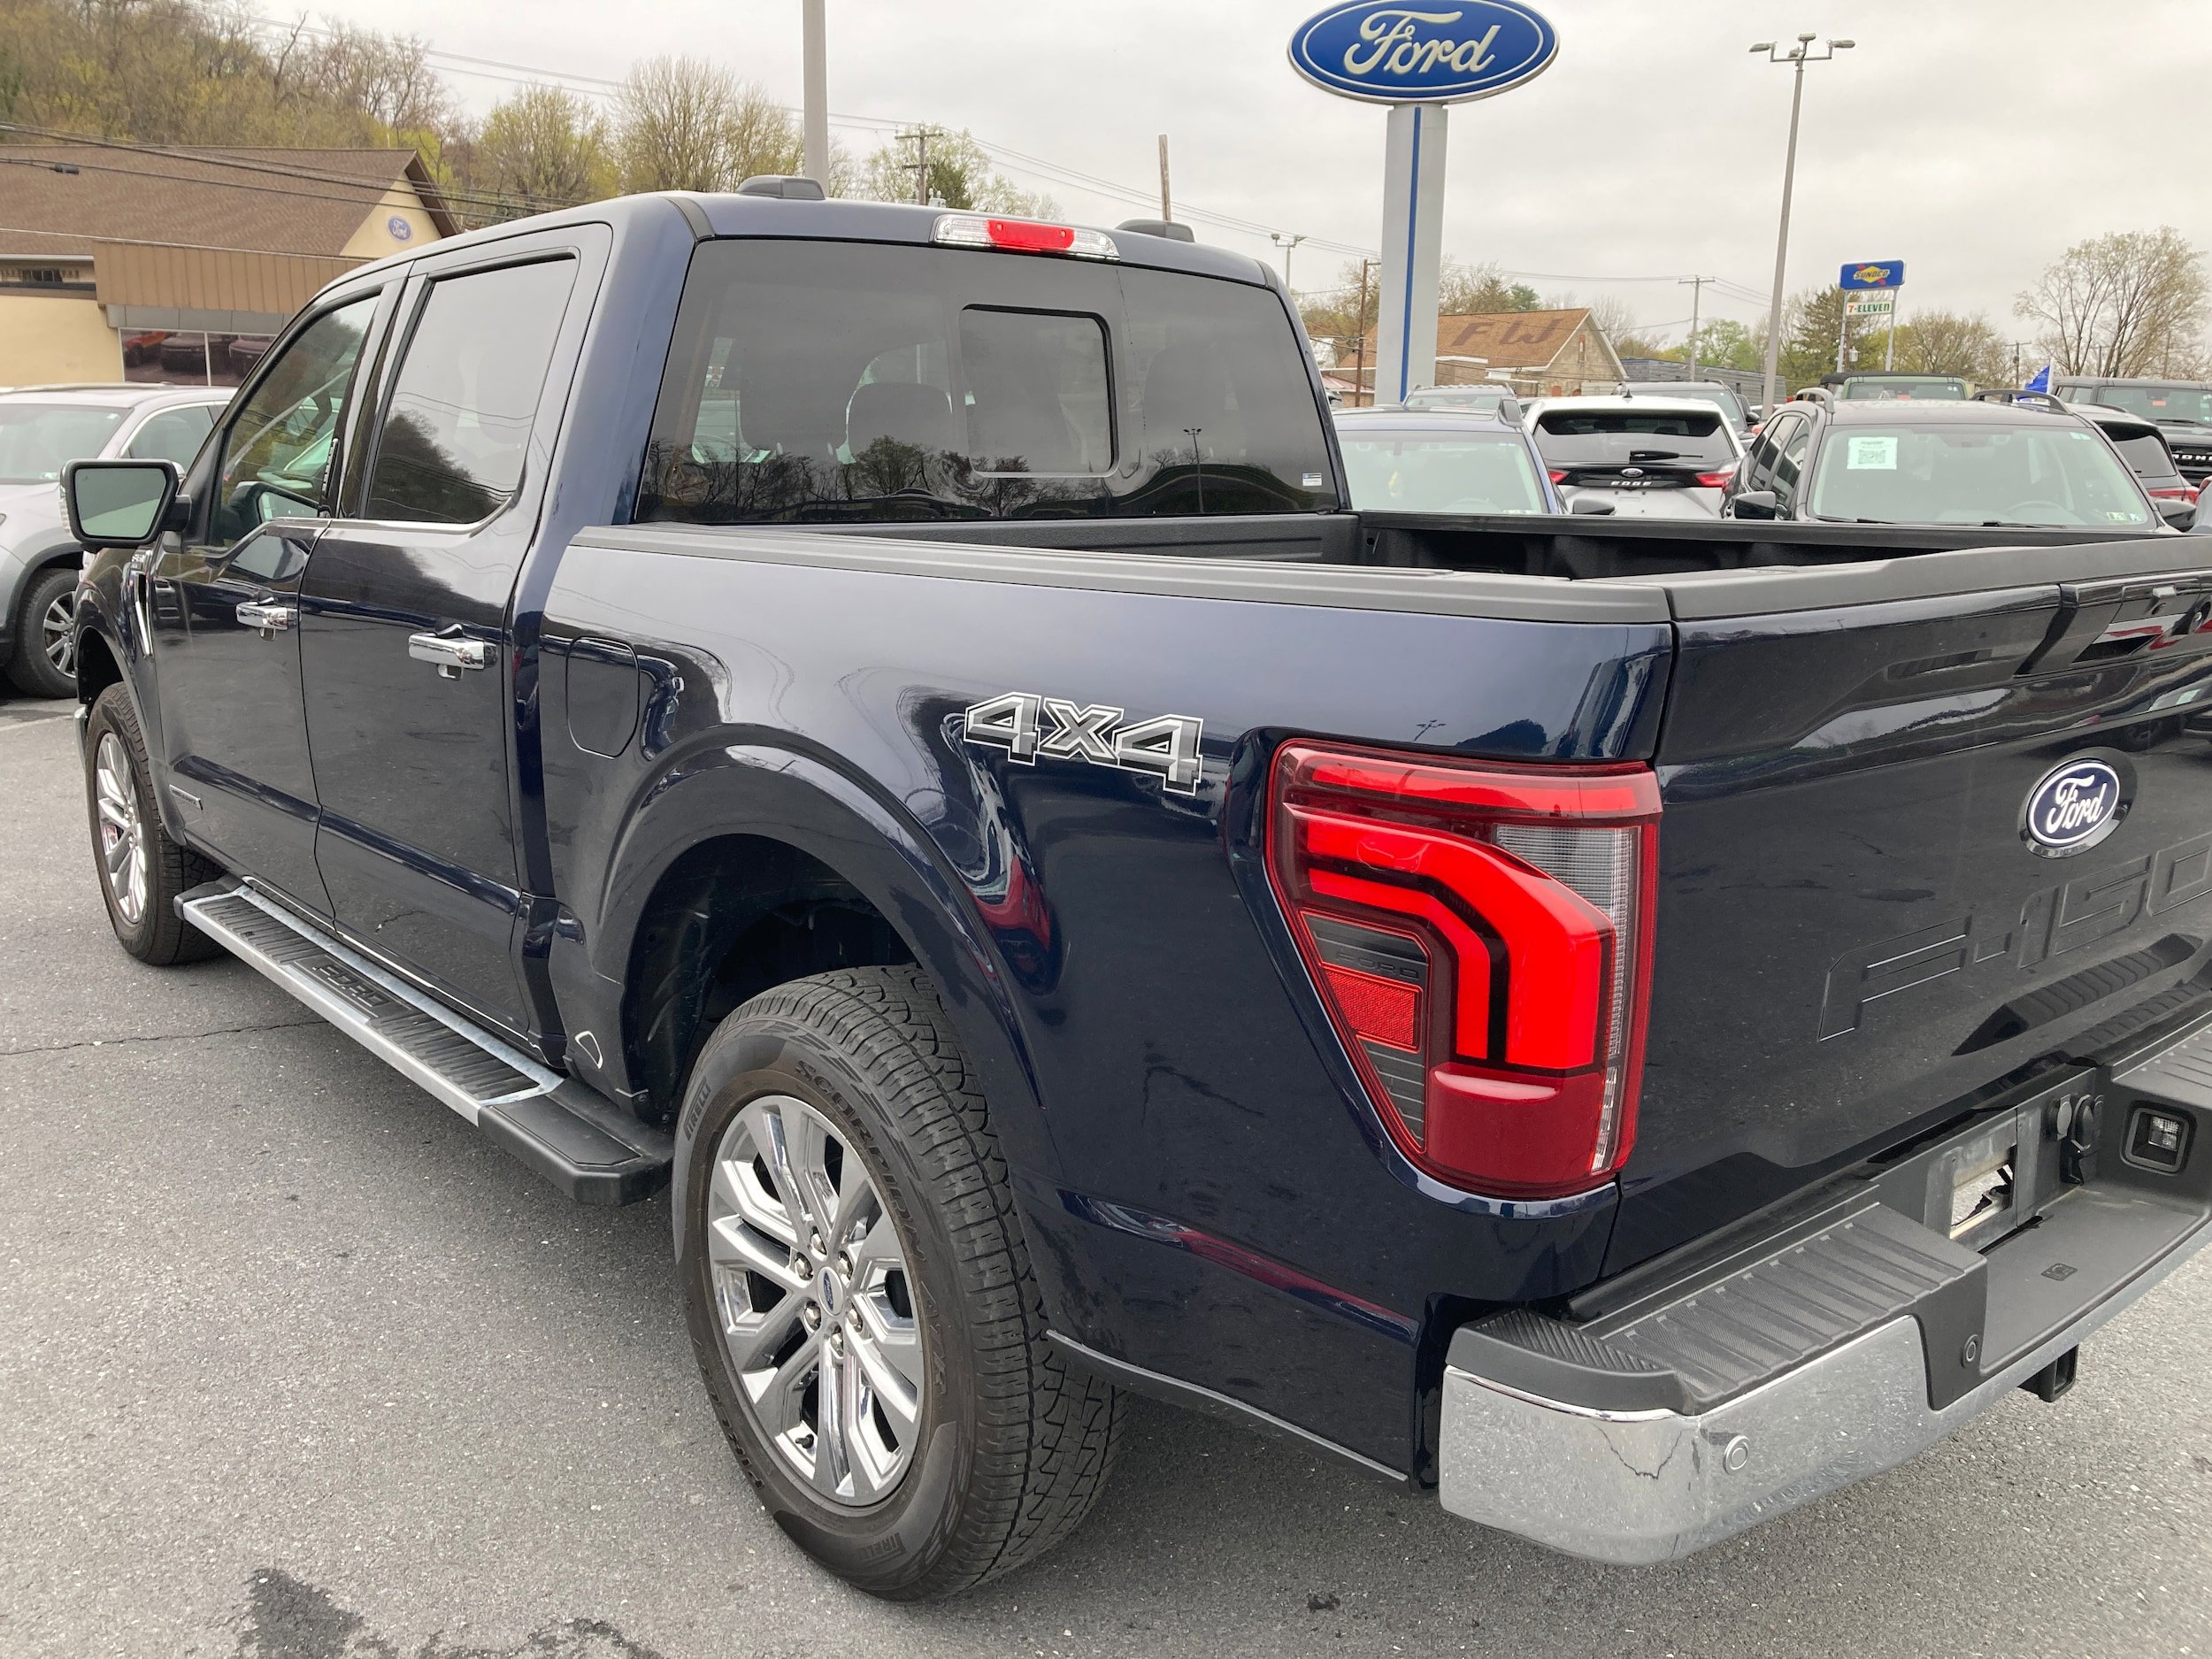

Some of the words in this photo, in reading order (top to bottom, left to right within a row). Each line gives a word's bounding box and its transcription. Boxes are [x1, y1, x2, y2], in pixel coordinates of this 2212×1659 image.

[1343, 10, 1502, 74] Ford
[392, 219, 408, 238] Ford
[2046, 774, 2108, 833] Ford
[311, 964, 390, 1007] FORD
[1337, 950, 1420, 981] FORD
[683, 1076, 711, 1141] PIRELLI
[795, 1060, 927, 1262] SCORPION
